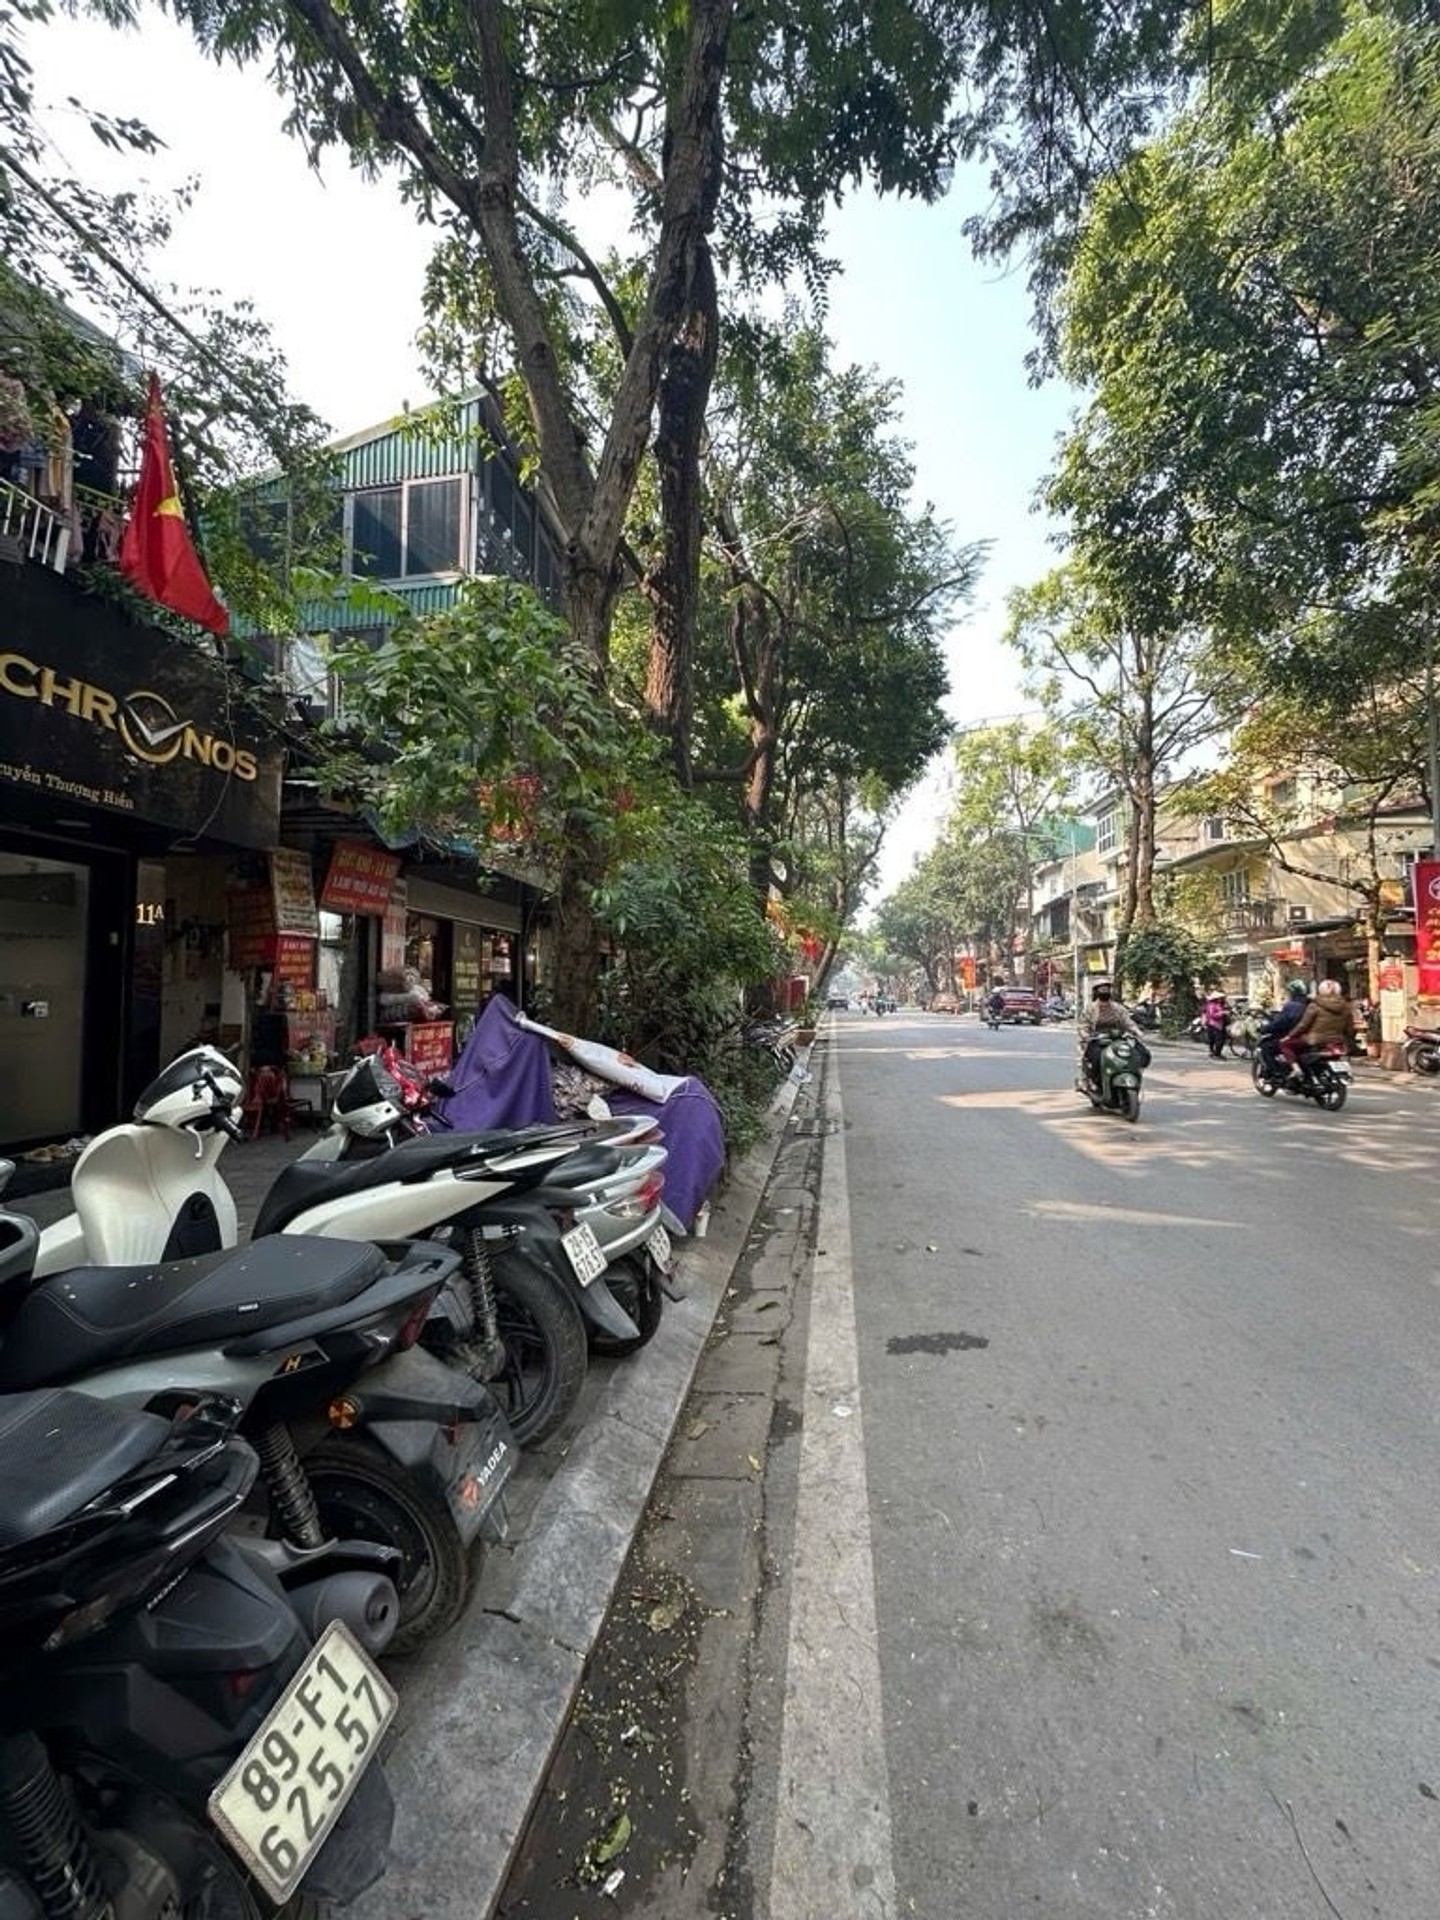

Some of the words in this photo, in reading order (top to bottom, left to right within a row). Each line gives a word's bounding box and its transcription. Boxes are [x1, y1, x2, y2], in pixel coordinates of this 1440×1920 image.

[0, 654, 257, 781] CHRONOS
[136, 903, 165, 925] 11A
[477, 1441, 507, 1487] YADEA
[241, 1654, 349, 1813] 89-F1
[259, 1674, 383, 1880] 625.57
